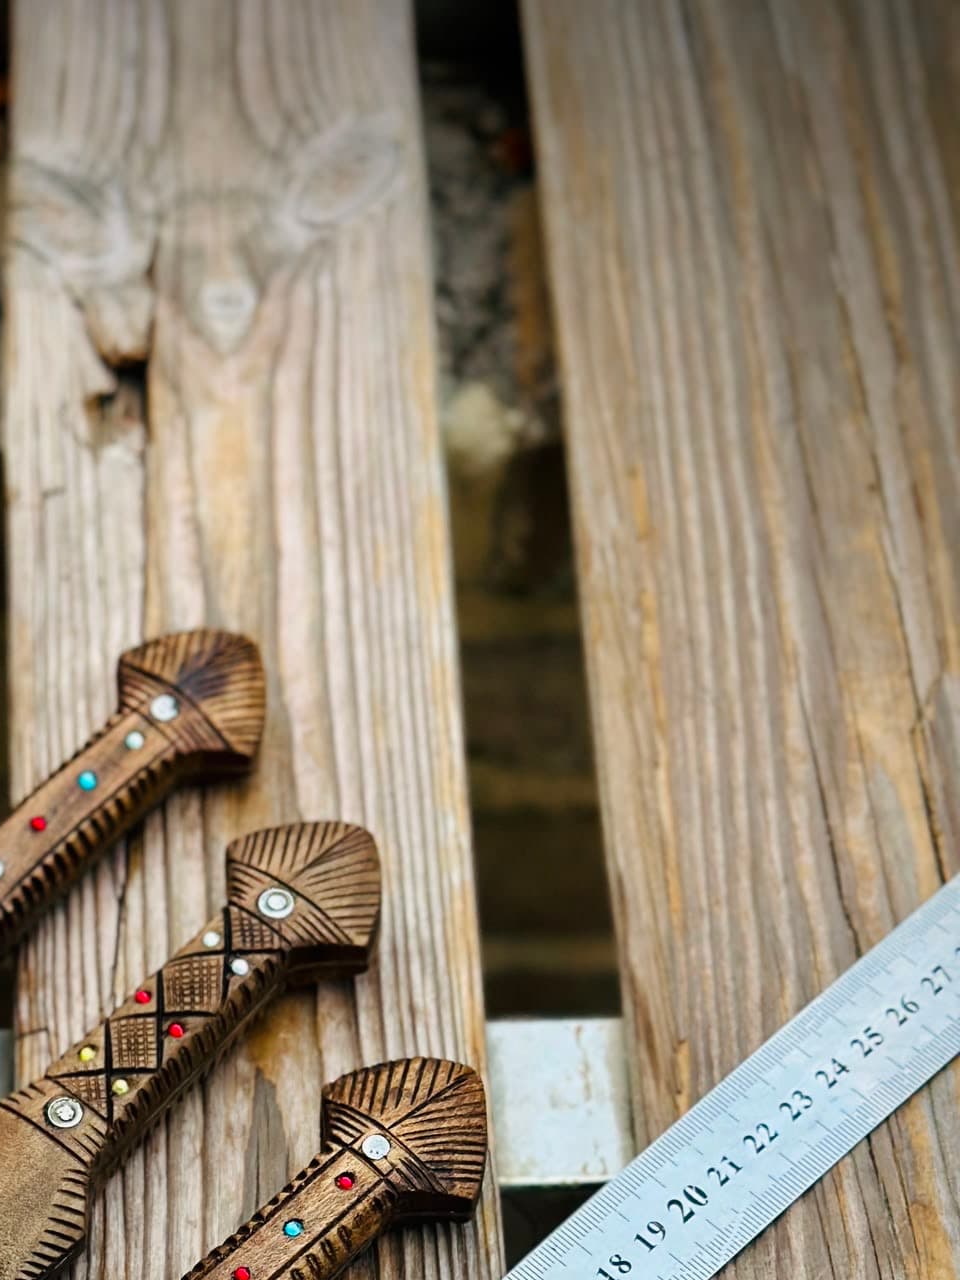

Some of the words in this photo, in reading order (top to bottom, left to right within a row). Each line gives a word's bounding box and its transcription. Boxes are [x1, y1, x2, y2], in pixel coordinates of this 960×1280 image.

[634, 1220, 666, 1251] 19
[667, 1185, 708, 1223] 20
[707, 1156, 743, 1187] 21
[743, 1122, 778, 1153] 22
[779, 1089, 813, 1121] 23
[815, 1058, 850, 1088] 24
[850, 1027, 884, 1057] 25
[886, 993, 920, 1026] 26
[920, 965, 952, 995] 27
